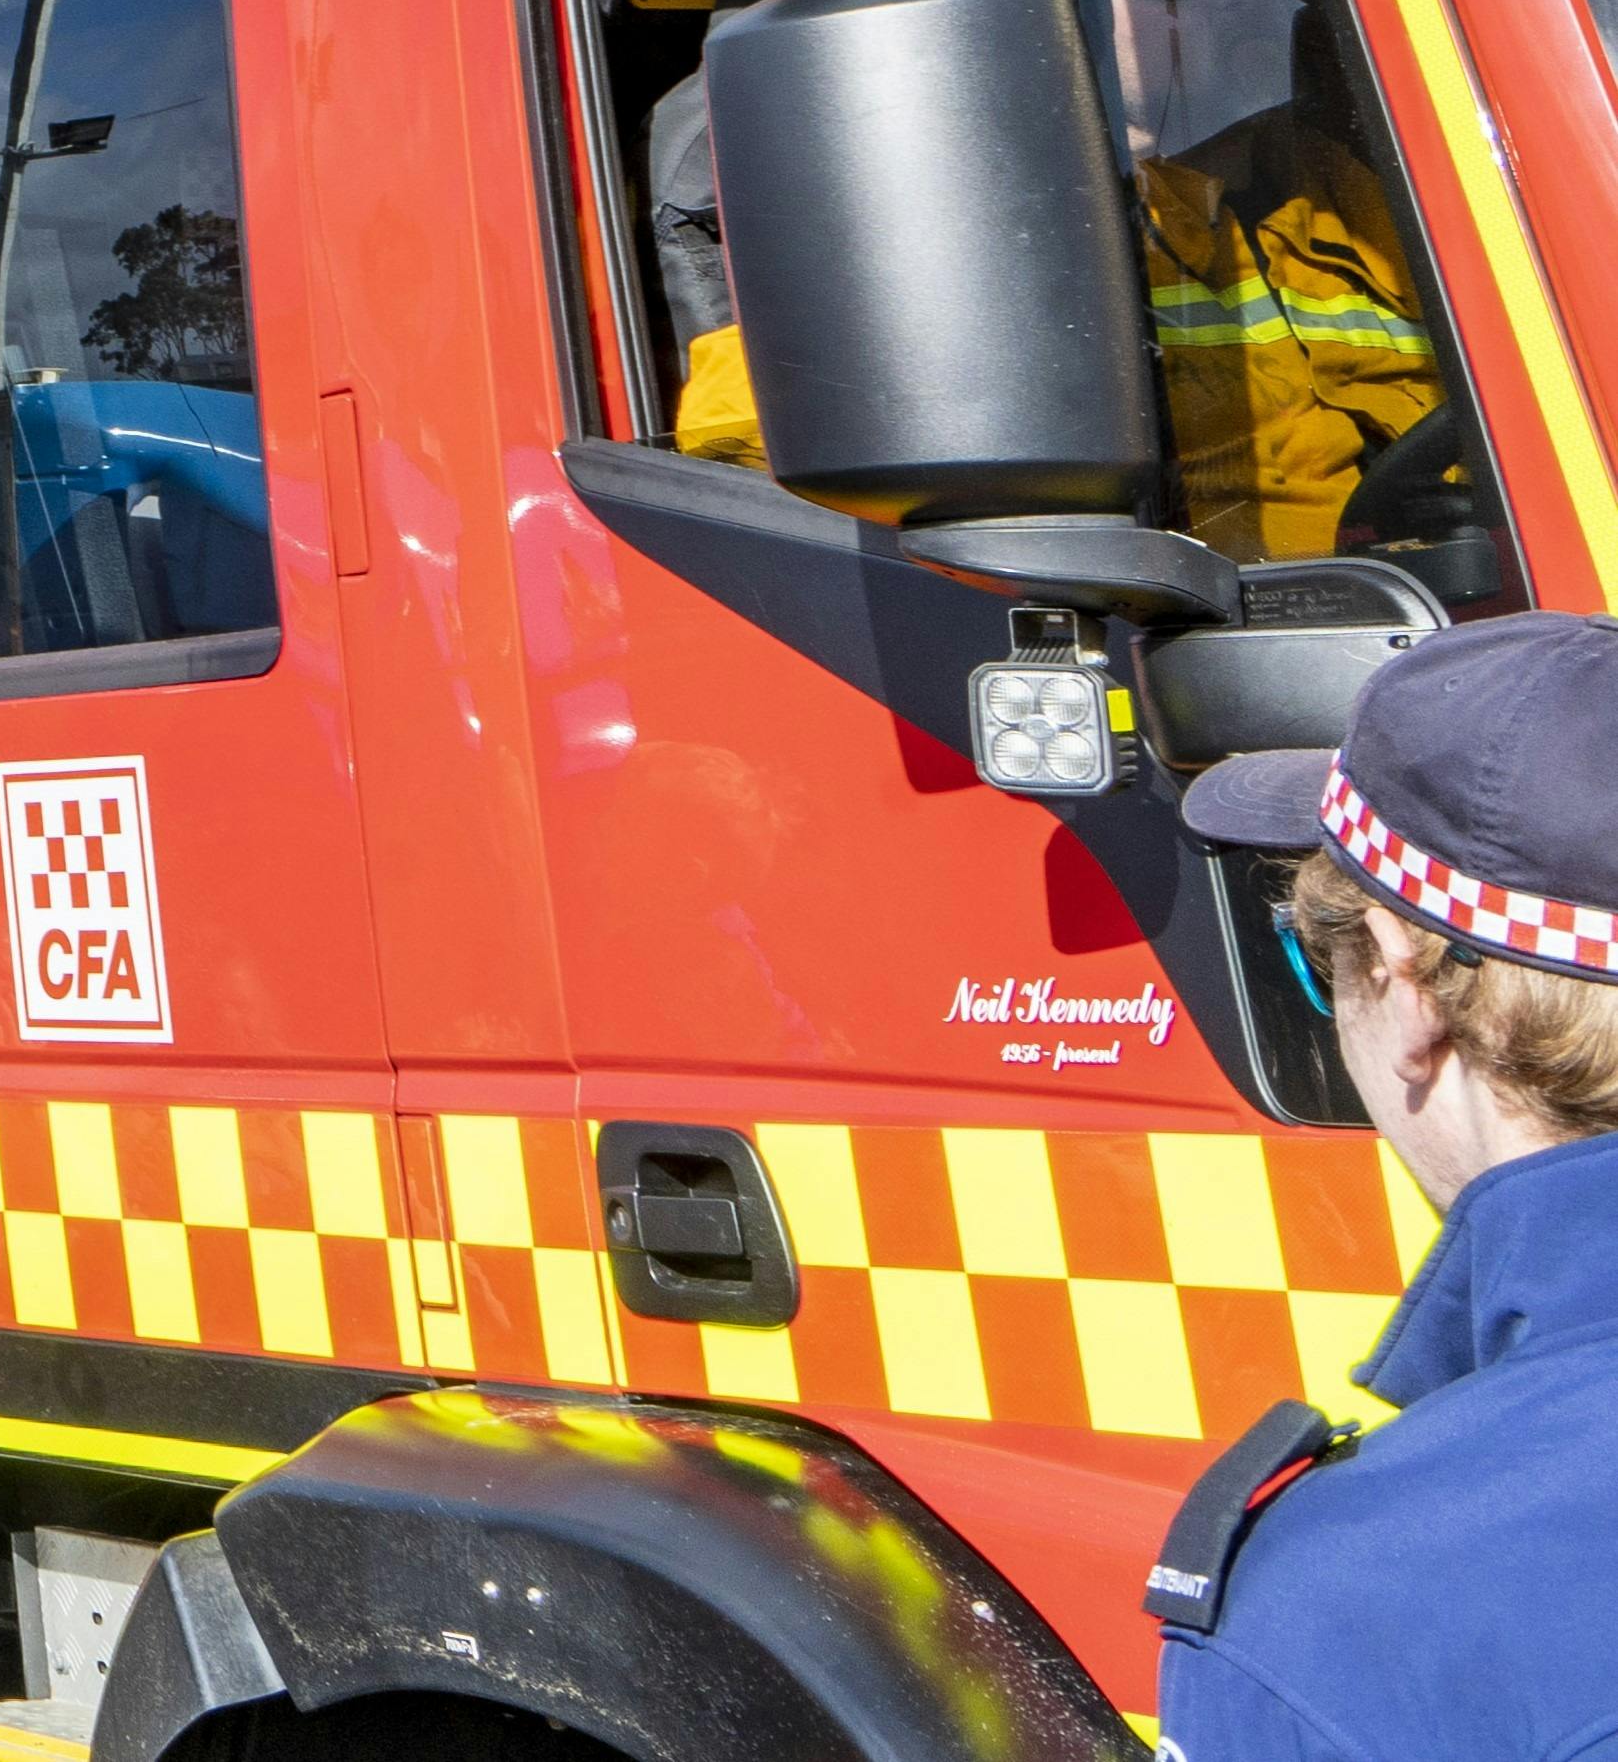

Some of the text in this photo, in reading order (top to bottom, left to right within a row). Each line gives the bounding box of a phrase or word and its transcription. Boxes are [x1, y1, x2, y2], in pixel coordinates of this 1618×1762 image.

[38, 928, 141, 999] CFA
[942, 976, 1175, 1045] Neil Kennedy
[1052, 1040, 1121, 1071] present
